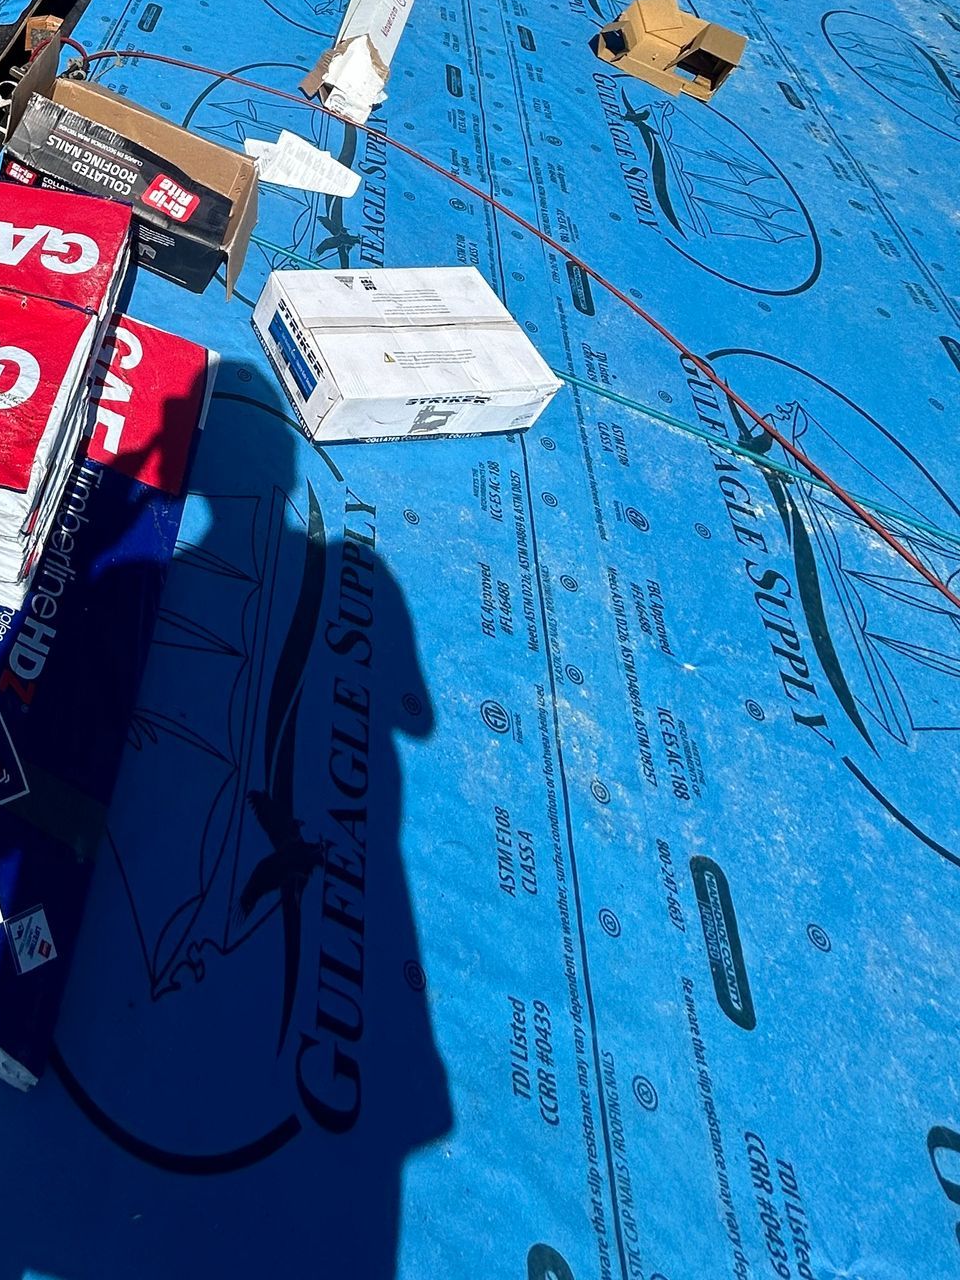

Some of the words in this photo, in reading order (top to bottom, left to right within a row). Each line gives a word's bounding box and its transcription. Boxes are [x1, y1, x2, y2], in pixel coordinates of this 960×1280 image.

[47, 134, 82, 160] NAILS
[83, 150, 138, 186] ROOFING
[592, 72, 638, 164] GULFEAGLE
[619, 161, 662, 234] SUPPLY
[71, 160, 132, 197] COLLATED
[160, 178, 193, 203] Rite
[149, 191, 187, 220] Grip
[277, 297, 325, 380] STRIKER
[406, 395, 491, 406] STRIKER
[490, 492, 504, 523] ICC-ES
[513, 493, 526, 515] ASTM
[324, 484, 378, 668] SUPPLY
[518, 549, 531, 573] ASTM
[477, 562, 493, 614] Approved
[481, 615, 496, 639] FBC
[524, 599, 539, 626] ASTM
[650, 600, 676, 657] Approved
[528, 624, 540, 654] Meets
[743, 556, 836, 749] SUPPLY
[657, 707, 679, 751] ICC-ES
[542, 730, 555, 776] footwear
[545, 776, 555, 790] or
[667, 751, 692, 801] AC-188
[494, 805, 512, 851] E108
[518, 829, 534, 841] A
[546, 788, 561, 845] conditions
[496, 850, 516, 898] ASTM
[519, 841, 538, 897] CLASS
[551, 843, 566, 885] surface
[656, 839, 686, 933] 800-247-6637
[295, 665, 373, 1138] GULFEAGLE
[557, 883, 573, 937] weather,
[562, 936, 574, 955] on
[563, 954, 585, 1019] dependent
[507, 995, 530, 1061] Listed
[533, 999, 553, 1067] #0439
[572, 1019, 586, 1055] vary
[511, 1069, 531, 1101] TDI
[576, 1055, 589, 1090] may
[601, 1050, 620, 1095] NAILS
[536, 1066, 560, 1128] CCRR
[578, 1088, 598, 1164] resistance
[607, 1091, 627, 1153] ROOFING
[586, 1163, 602, 1196] slip
[744, 1130, 774, 1195] CCRR
[775, 1157, 799, 1195] TDI
[615, 1163, 633, 1211] NAILS
[590, 1195, 607, 1233] that
[620, 1210, 640, 1244] CAP
[756, 1193, 791, 1280] #0439
[785, 1196, 814, 1280] Listed
